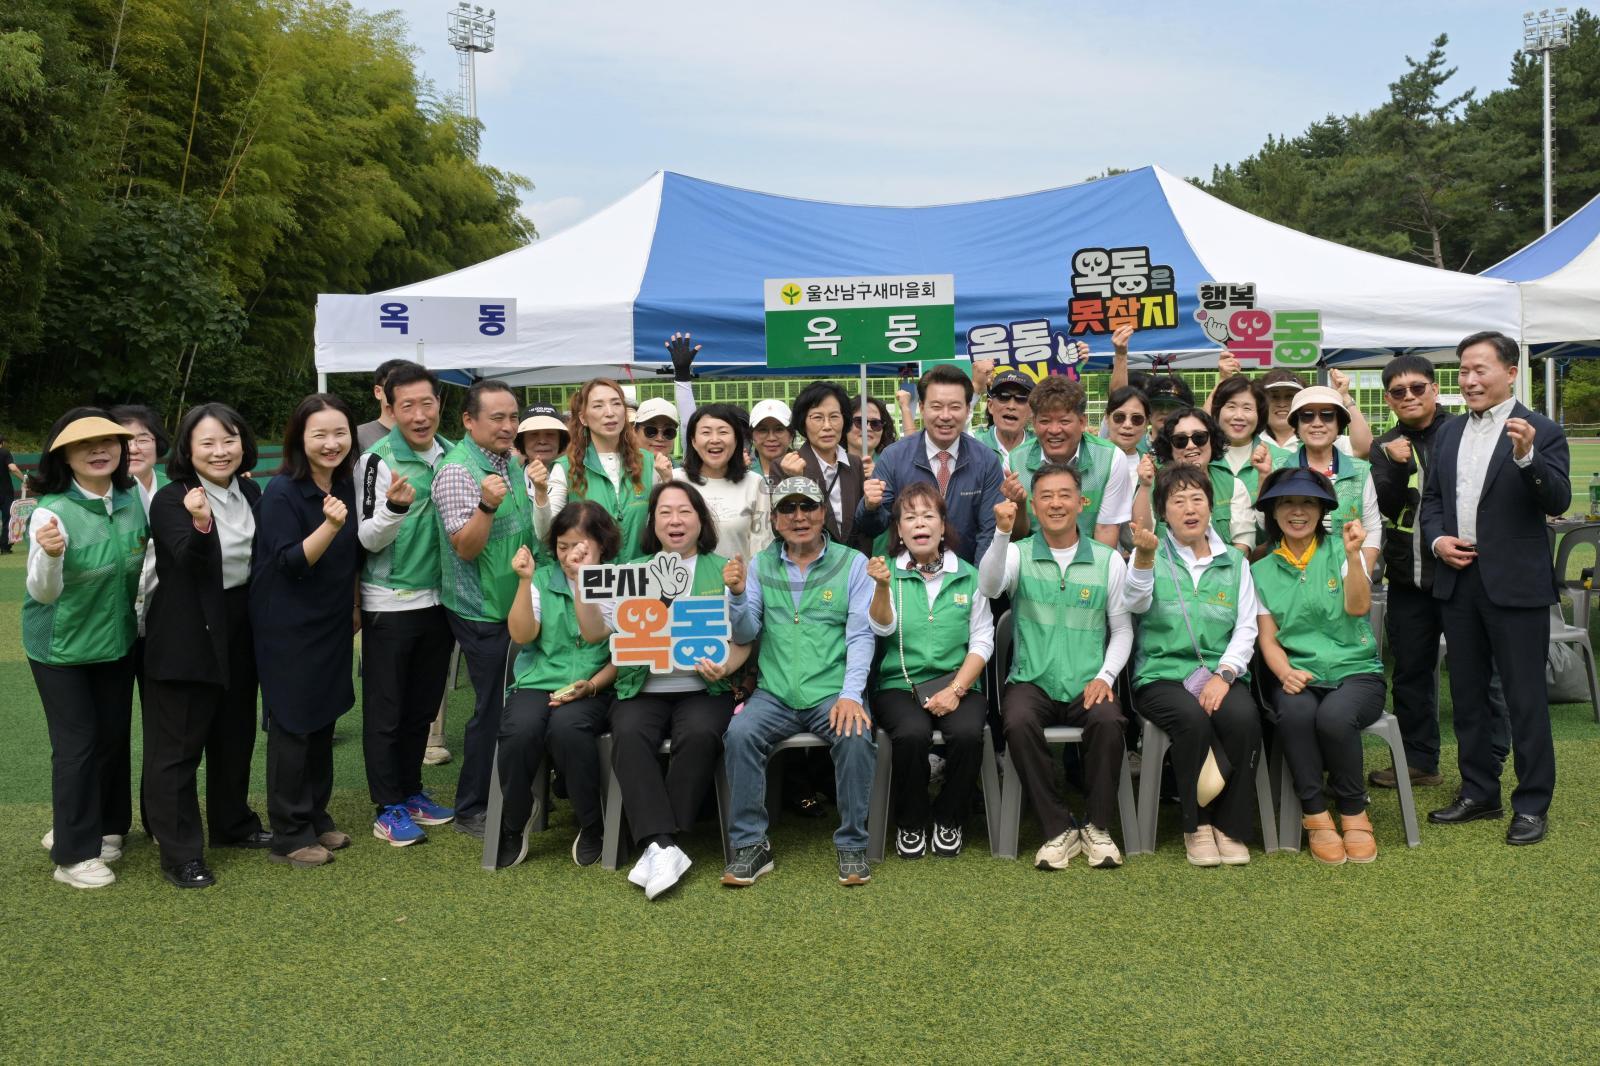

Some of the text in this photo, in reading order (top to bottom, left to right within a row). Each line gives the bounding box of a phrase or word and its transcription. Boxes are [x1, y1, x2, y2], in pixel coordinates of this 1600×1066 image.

[806, 281, 936, 302] 울산남구새마을회
[1200, 284, 1255, 310] 행복
[1071, 294, 1175, 334] 못참지
[969, 321, 1053, 364] 옥동
[1226, 310, 1321, 366] 옥동
[583, 567, 650, 600] 만사
[614, 598, 728, 670] 옥동
